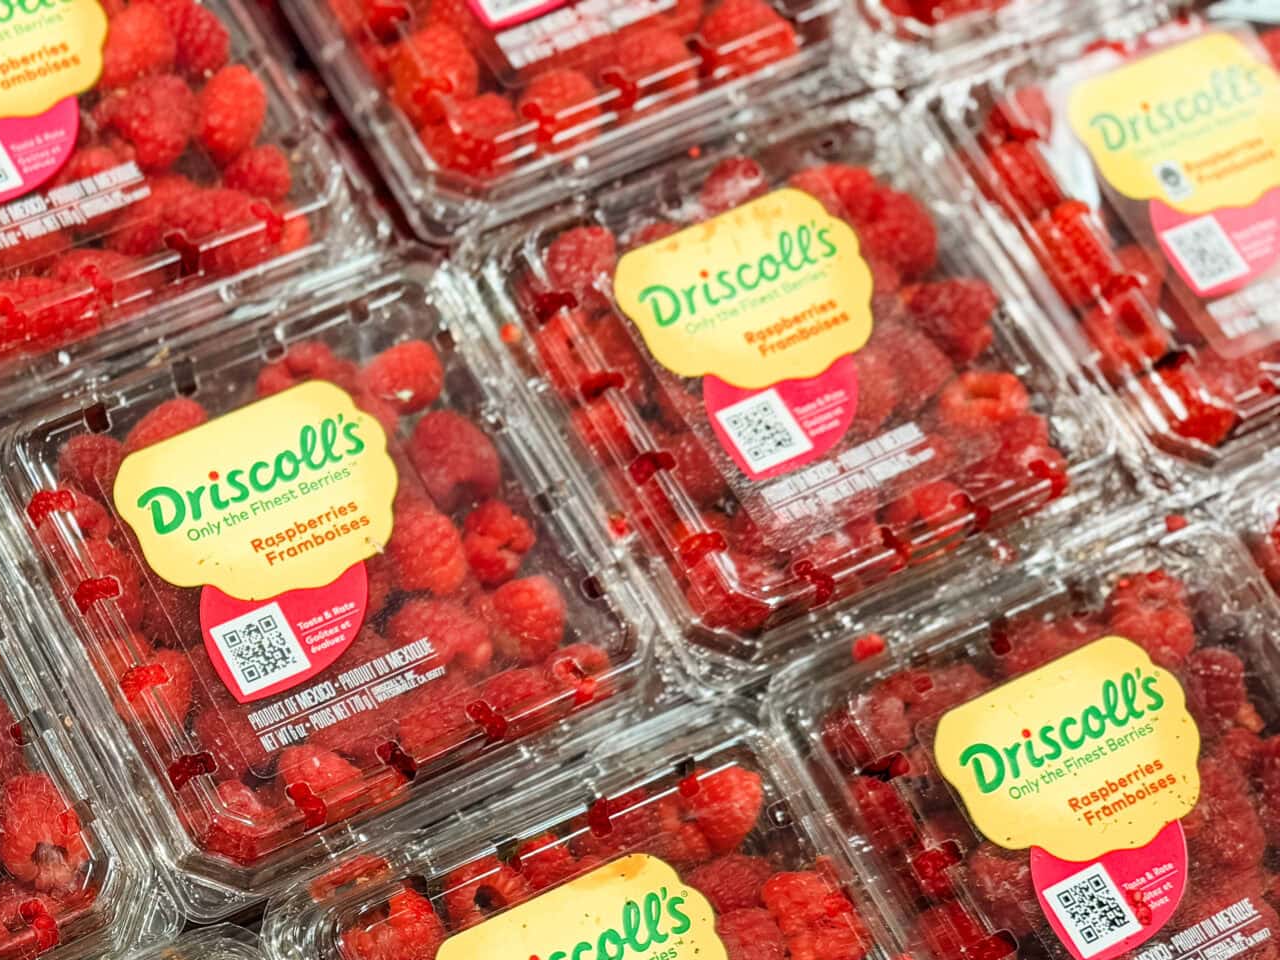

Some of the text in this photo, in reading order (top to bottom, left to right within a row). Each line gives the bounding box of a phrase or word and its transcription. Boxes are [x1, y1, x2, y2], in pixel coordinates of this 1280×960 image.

[743, 299, 837, 345] Raspberries
[758, 311, 849, 357] Framboises
[187, 519, 220, 542] Only
[222, 510, 250, 527] the
[250, 487, 298, 516] Finest
[250, 500, 358, 552] Raspberries
[265, 515, 370, 566] Framboises
[1008, 777, 1039, 801] Only
[1040, 768, 1065, 785] the
[1063, 744, 1108, 774] Finest
[1068, 758, 1164, 812] Raspberries
[1083, 773, 1176, 826] Framboises
